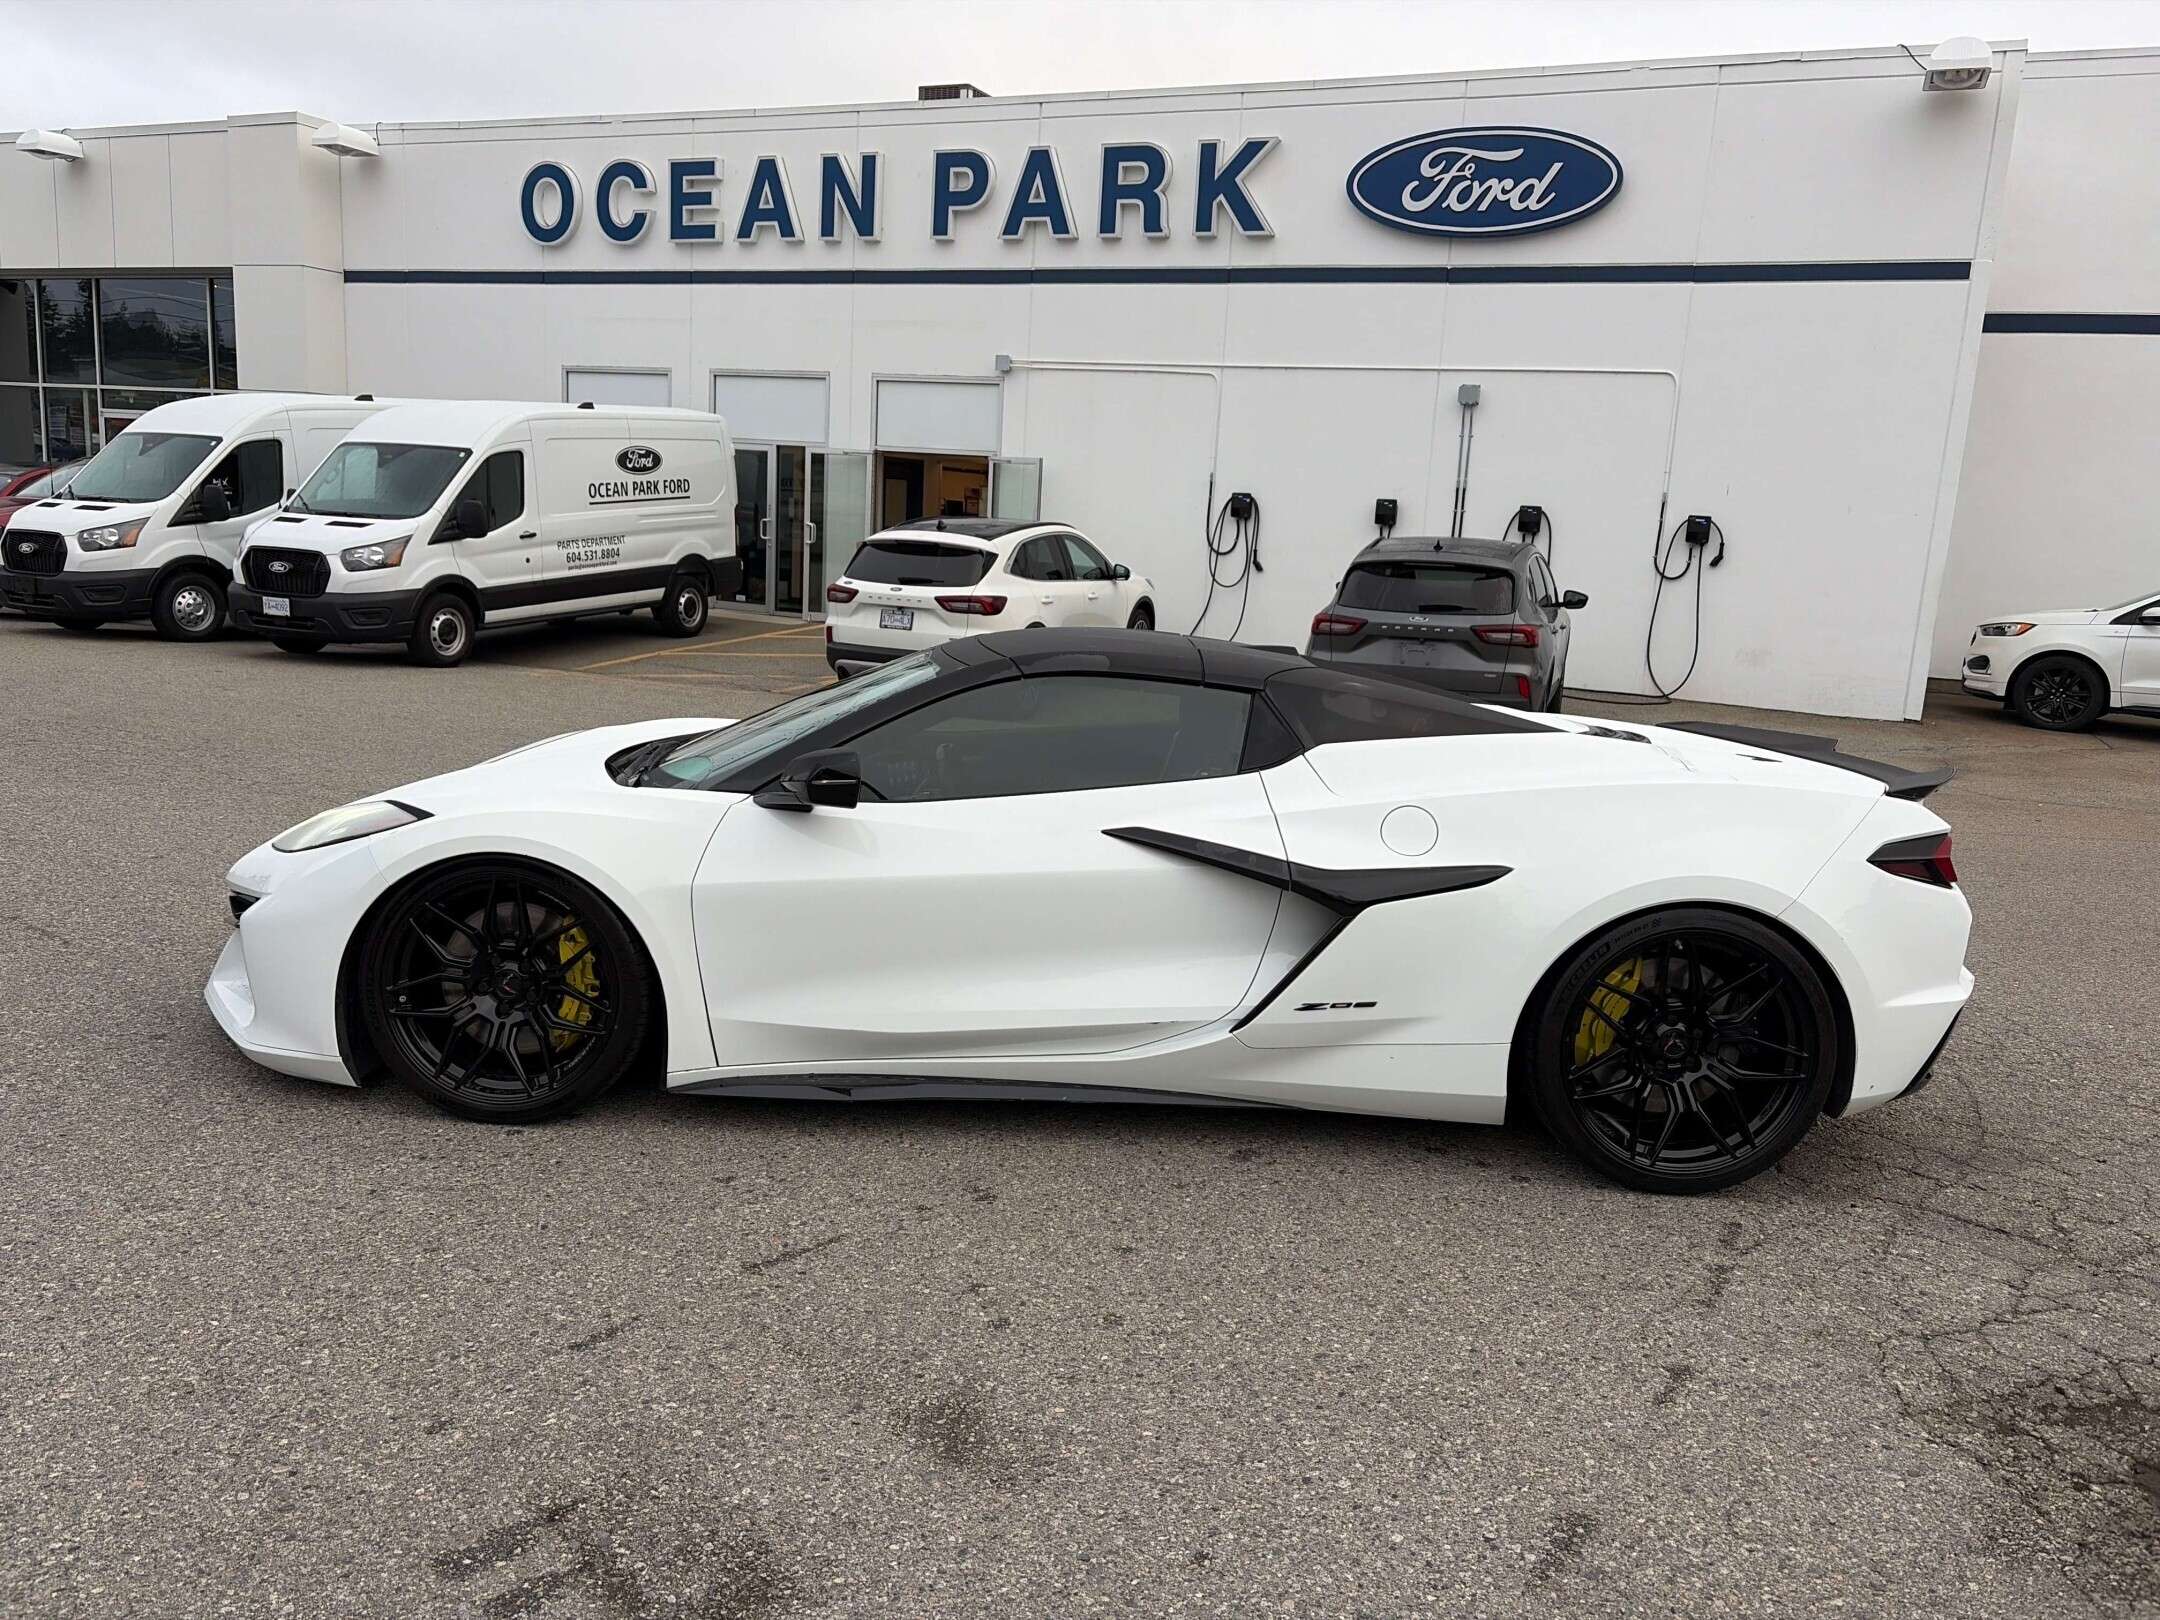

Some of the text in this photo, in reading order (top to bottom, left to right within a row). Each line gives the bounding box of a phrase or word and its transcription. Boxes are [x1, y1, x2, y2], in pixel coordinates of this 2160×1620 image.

[1401, 146, 1564, 212] Ford
[520, 136, 1281, 246] OCEAN PARK
[626, 448, 654, 468] Ford
[588, 478, 691, 499] OCEAN PARK FORD
[556, 534, 625, 550] PARTS DEPARTMENT
[566, 547, 620, 563] 604.531.8804
